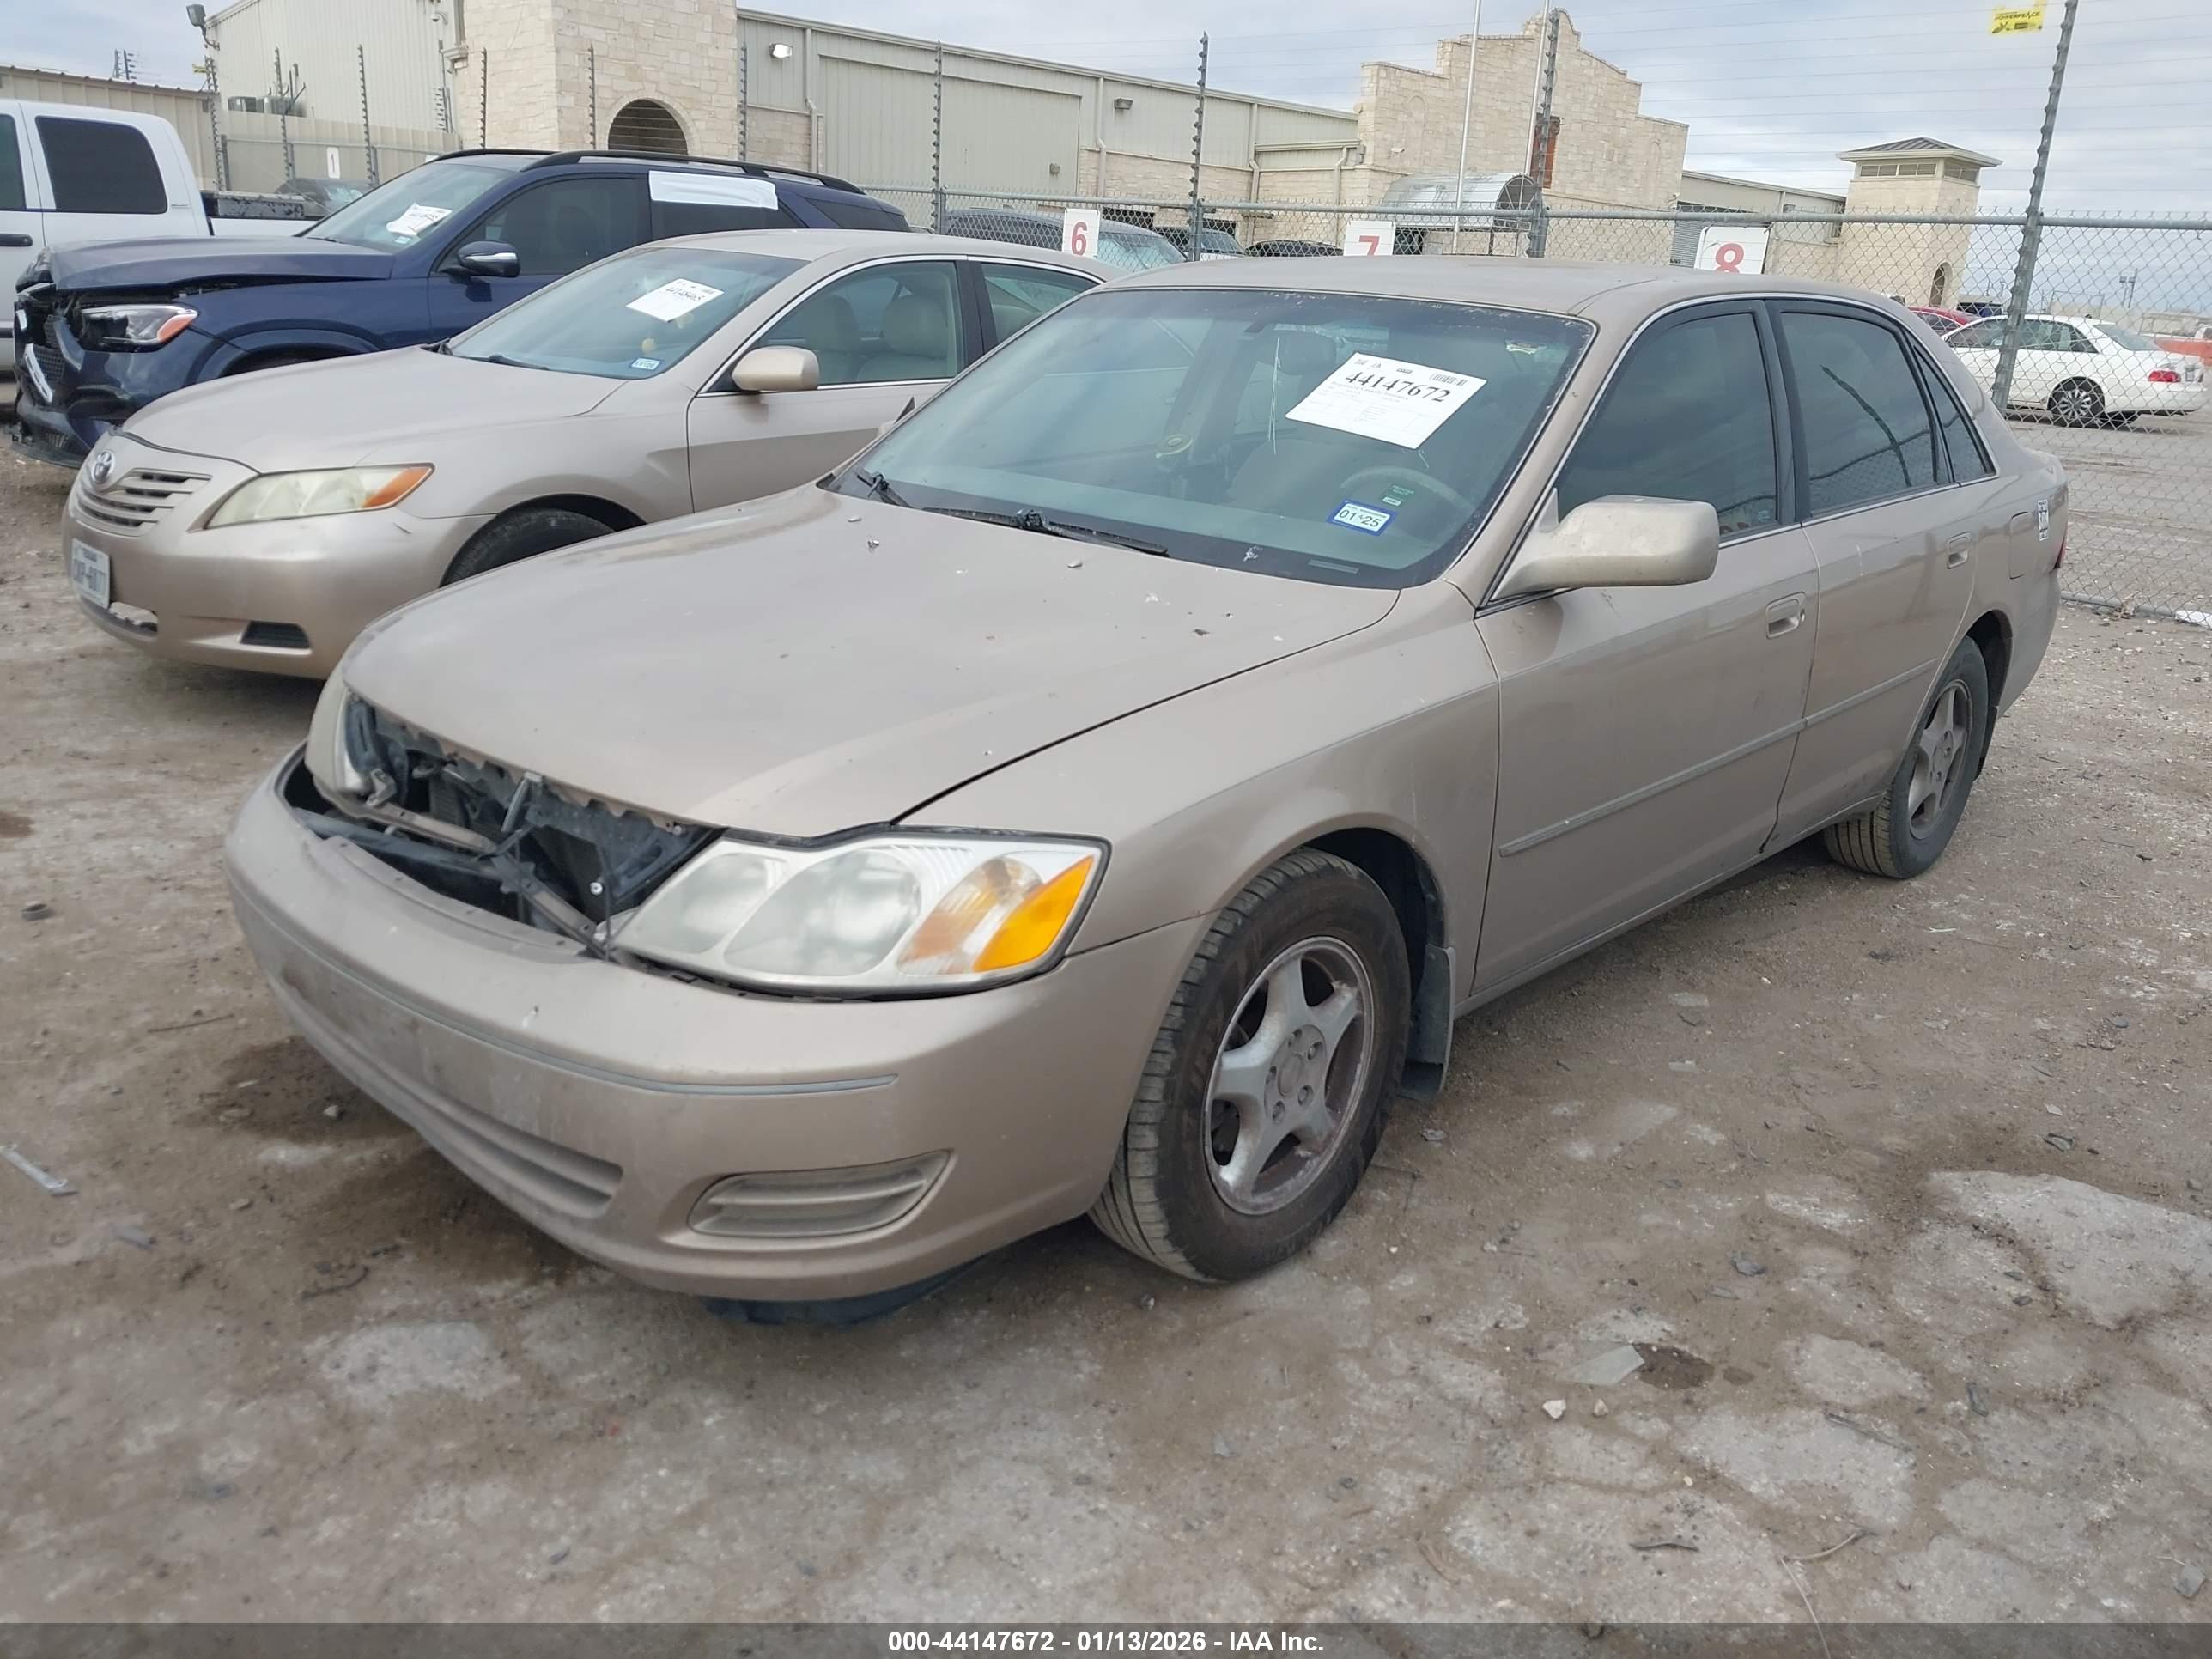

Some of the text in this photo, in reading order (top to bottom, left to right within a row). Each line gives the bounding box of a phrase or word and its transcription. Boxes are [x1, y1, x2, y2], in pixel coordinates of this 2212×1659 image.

[331, 153, 336, 173] 1
[1071, 221, 1088, 256] 6
[1358, 234, 1380, 257] 7
[1714, 243, 1745, 274] 8
[1346, 372, 1452, 403] 44147672
[1339, 509, 1357, 520] 01
[1361, 515, 1382, 527] 25
